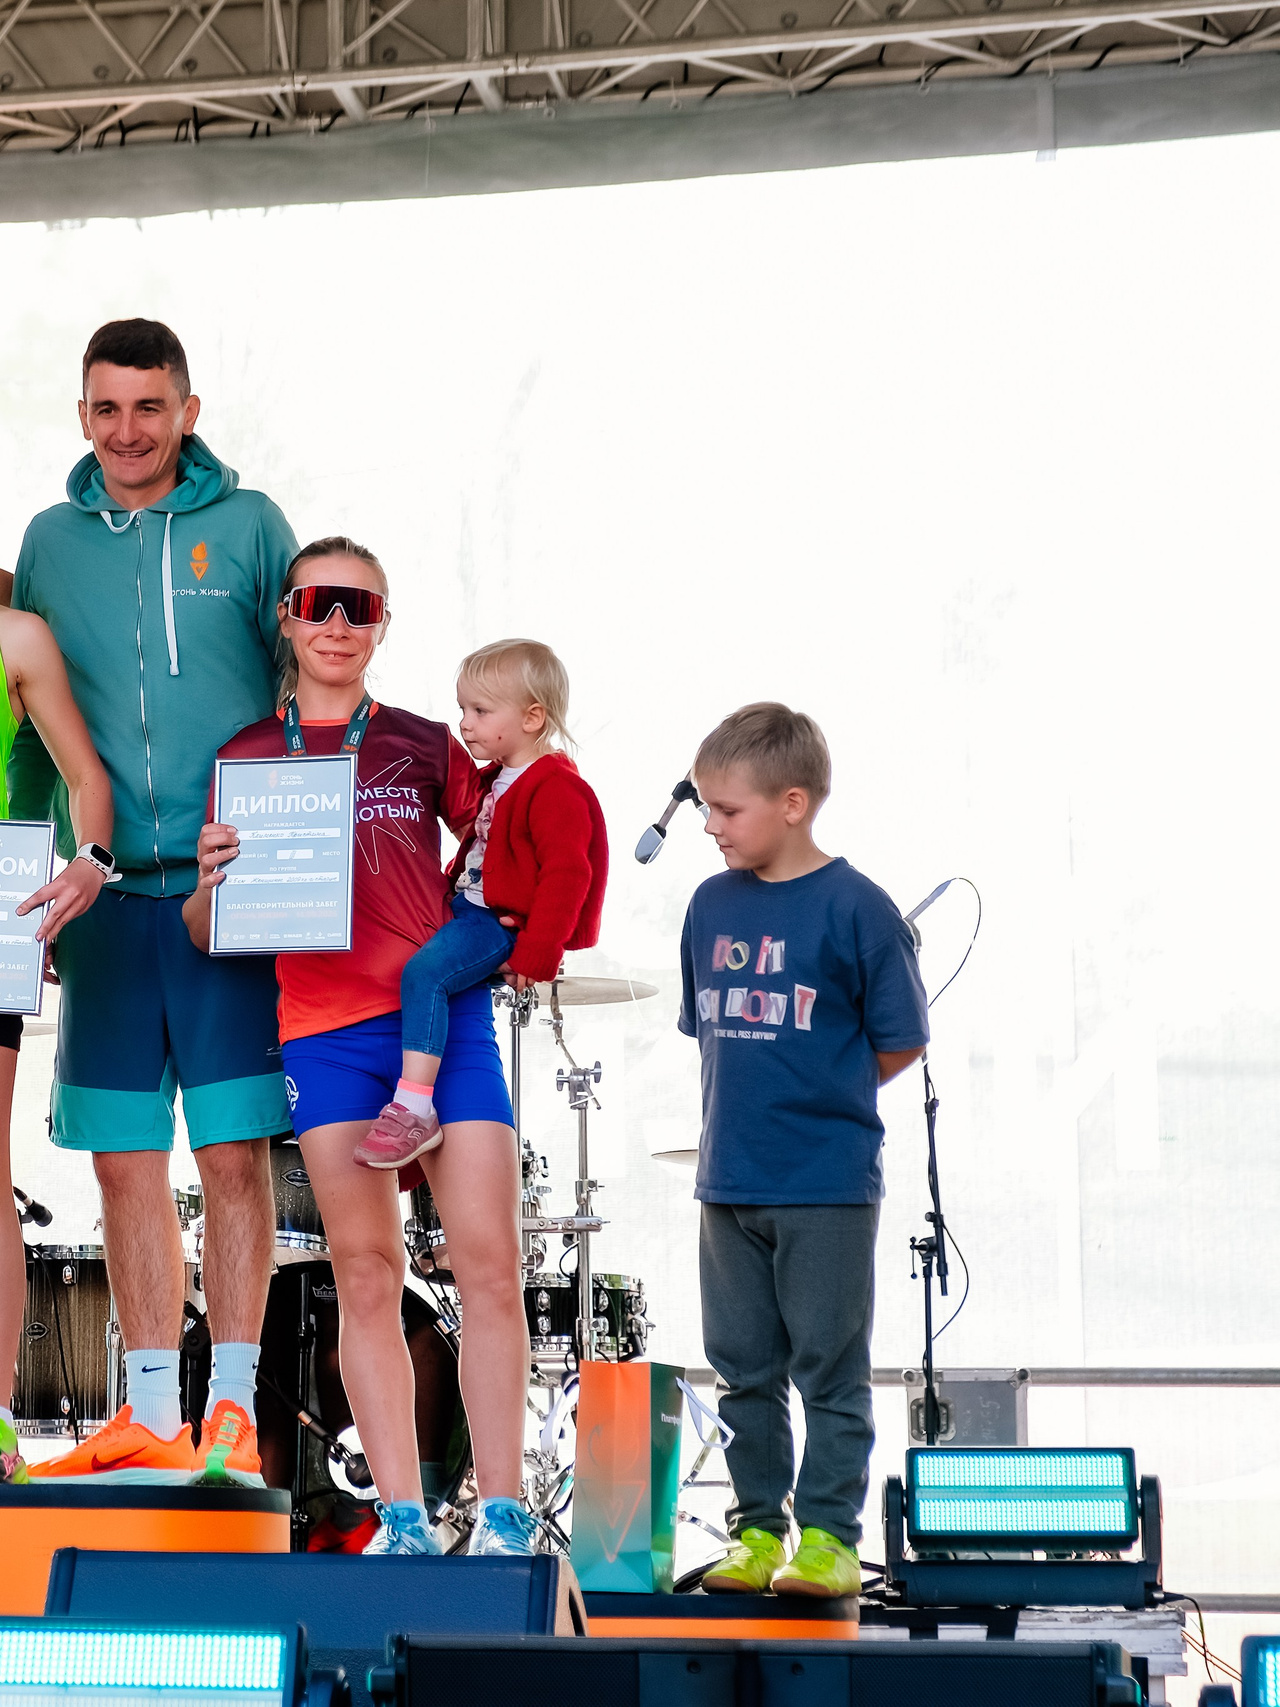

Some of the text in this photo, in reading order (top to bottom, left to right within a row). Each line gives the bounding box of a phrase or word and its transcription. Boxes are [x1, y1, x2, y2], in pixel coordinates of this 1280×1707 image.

[199, 588, 230, 598] ЖИЗНИ
[356, 787, 421, 803] МЕСТЕ
[229, 793, 341, 818] ДИПЛОМ
[226, 900, 338, 910] БЛАГОТВОРИТЕЛЬНЫЙ ЗАБЕГ
[712, 936, 751, 971] DO
[7, 962, 30, 971] ЗАБЕГ
[737, 1030, 752, 1040] PASS
[752, 1031, 778, 1041] ANYWAY
